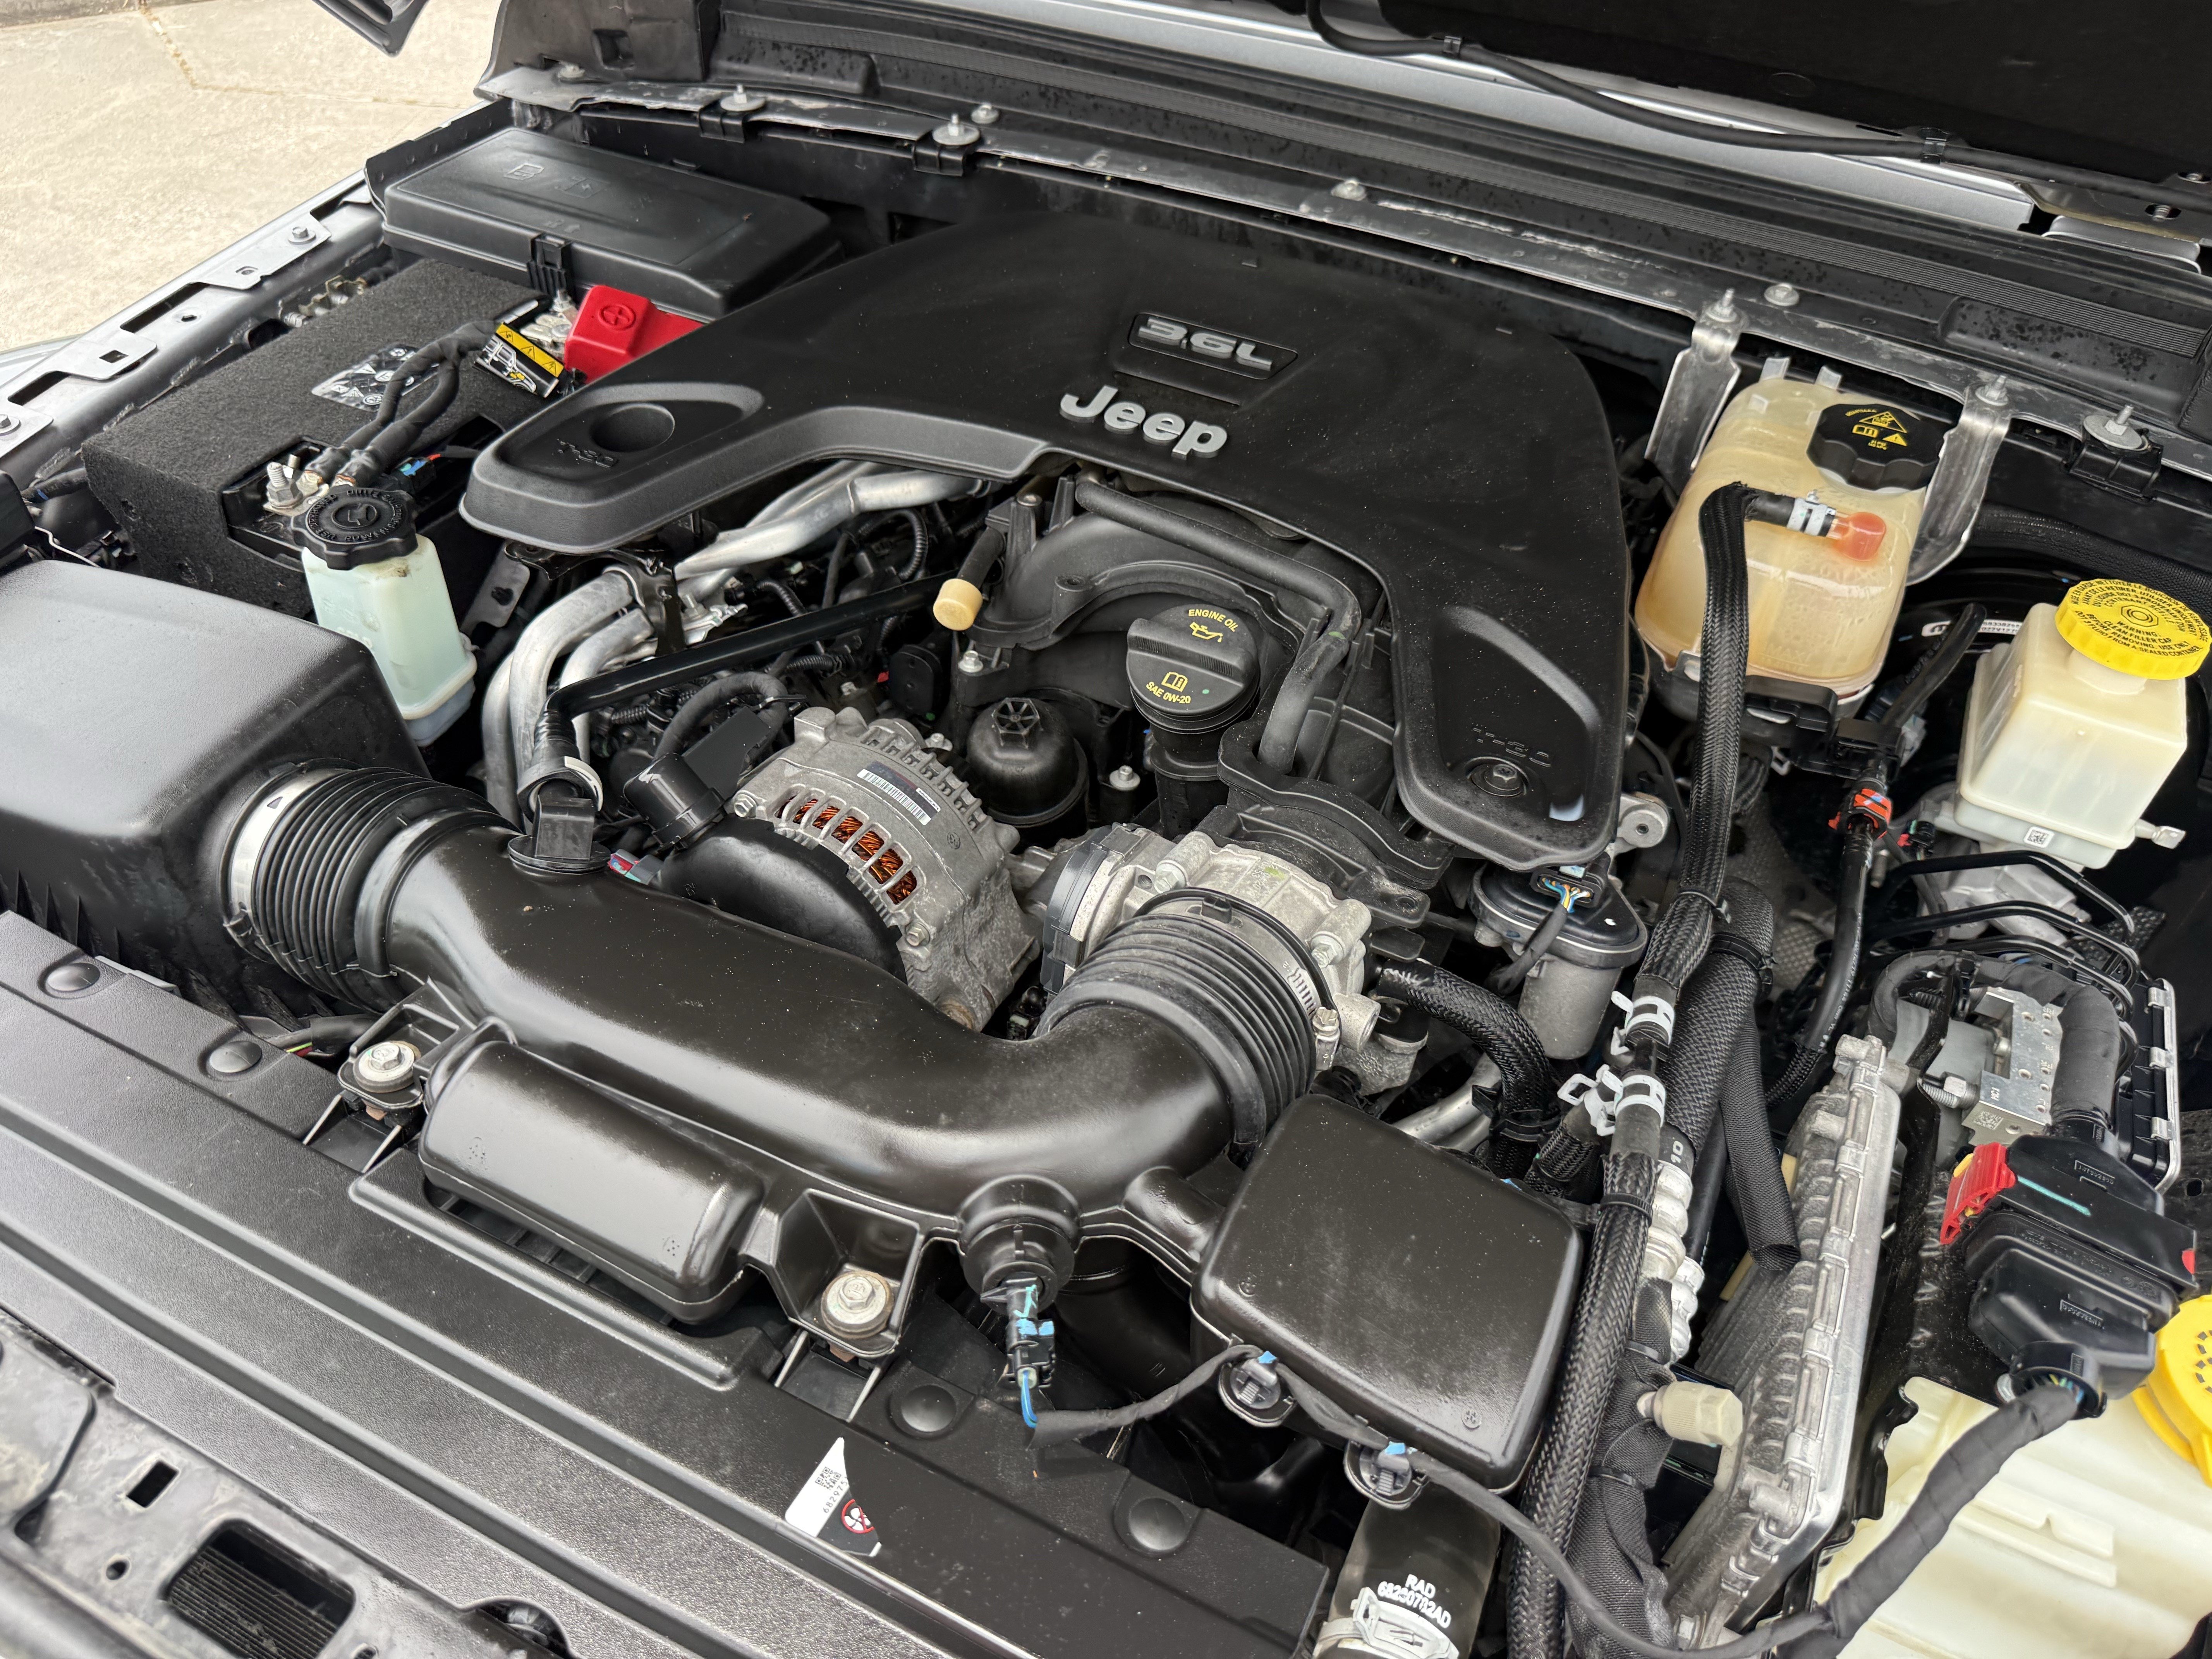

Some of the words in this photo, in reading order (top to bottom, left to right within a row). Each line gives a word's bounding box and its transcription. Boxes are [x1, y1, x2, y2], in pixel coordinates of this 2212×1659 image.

[1138, 316, 1272, 371] 3.6L
[1060, 385, 1227, 460] Jeep
[2104, 597, 2147, 607] CONTENANT
[2140, 591, 2173, 607] UTILISER
[2145, 586, 2181, 605] BOUCHON
[1188, 609, 1226, 622] ENGINE
[1224, 619, 1238, 632] OIL
[2140, 596, 2182, 621] PROVENANT
[2075, 610, 2088, 620] DOT
[2088, 623, 2109, 636] FLUID
[2107, 635, 2130, 647] FROM
[2139, 647, 2169, 656] SEALED
[2168, 645, 2203, 656] CONTAINER
[2086, 613, 2111, 632] BEFORE
[2173, 641, 2191, 649] ONLY
[2103, 620, 2128, 635] CLEAN
[2129, 633, 2158, 644] FILLER
[1146, 681, 1164, 697] SAE
[1163, 692, 1191, 704] 0W-20
[1405, 1574, 1436, 1599] RAD
